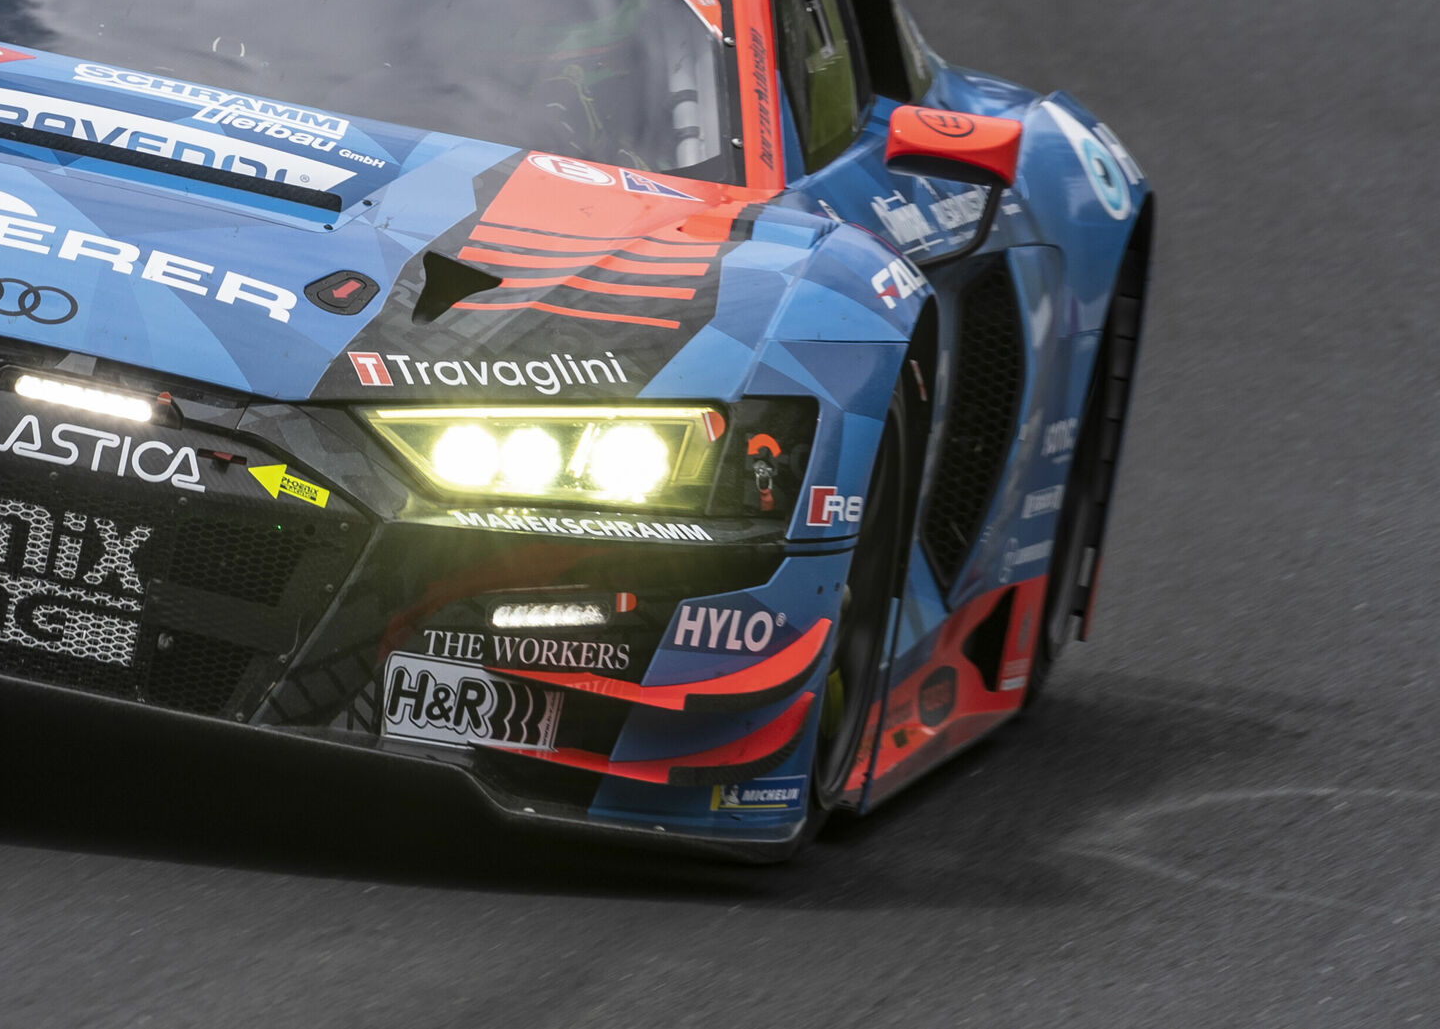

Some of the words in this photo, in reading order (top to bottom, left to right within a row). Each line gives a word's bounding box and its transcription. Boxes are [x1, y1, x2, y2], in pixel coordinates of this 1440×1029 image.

[74, 63, 349, 140] SCHRAMM
[191, 106, 338, 153] Tiefbau
[338, 148, 385, 169] GmbH
[386, 351, 629, 395] Travaglini
[423, 629, 485, 662] THE
[492, 635, 631, 670] WORKERS
[386, 667, 490, 732] H&R
[742, 787, 800, 802] MICHELIN
